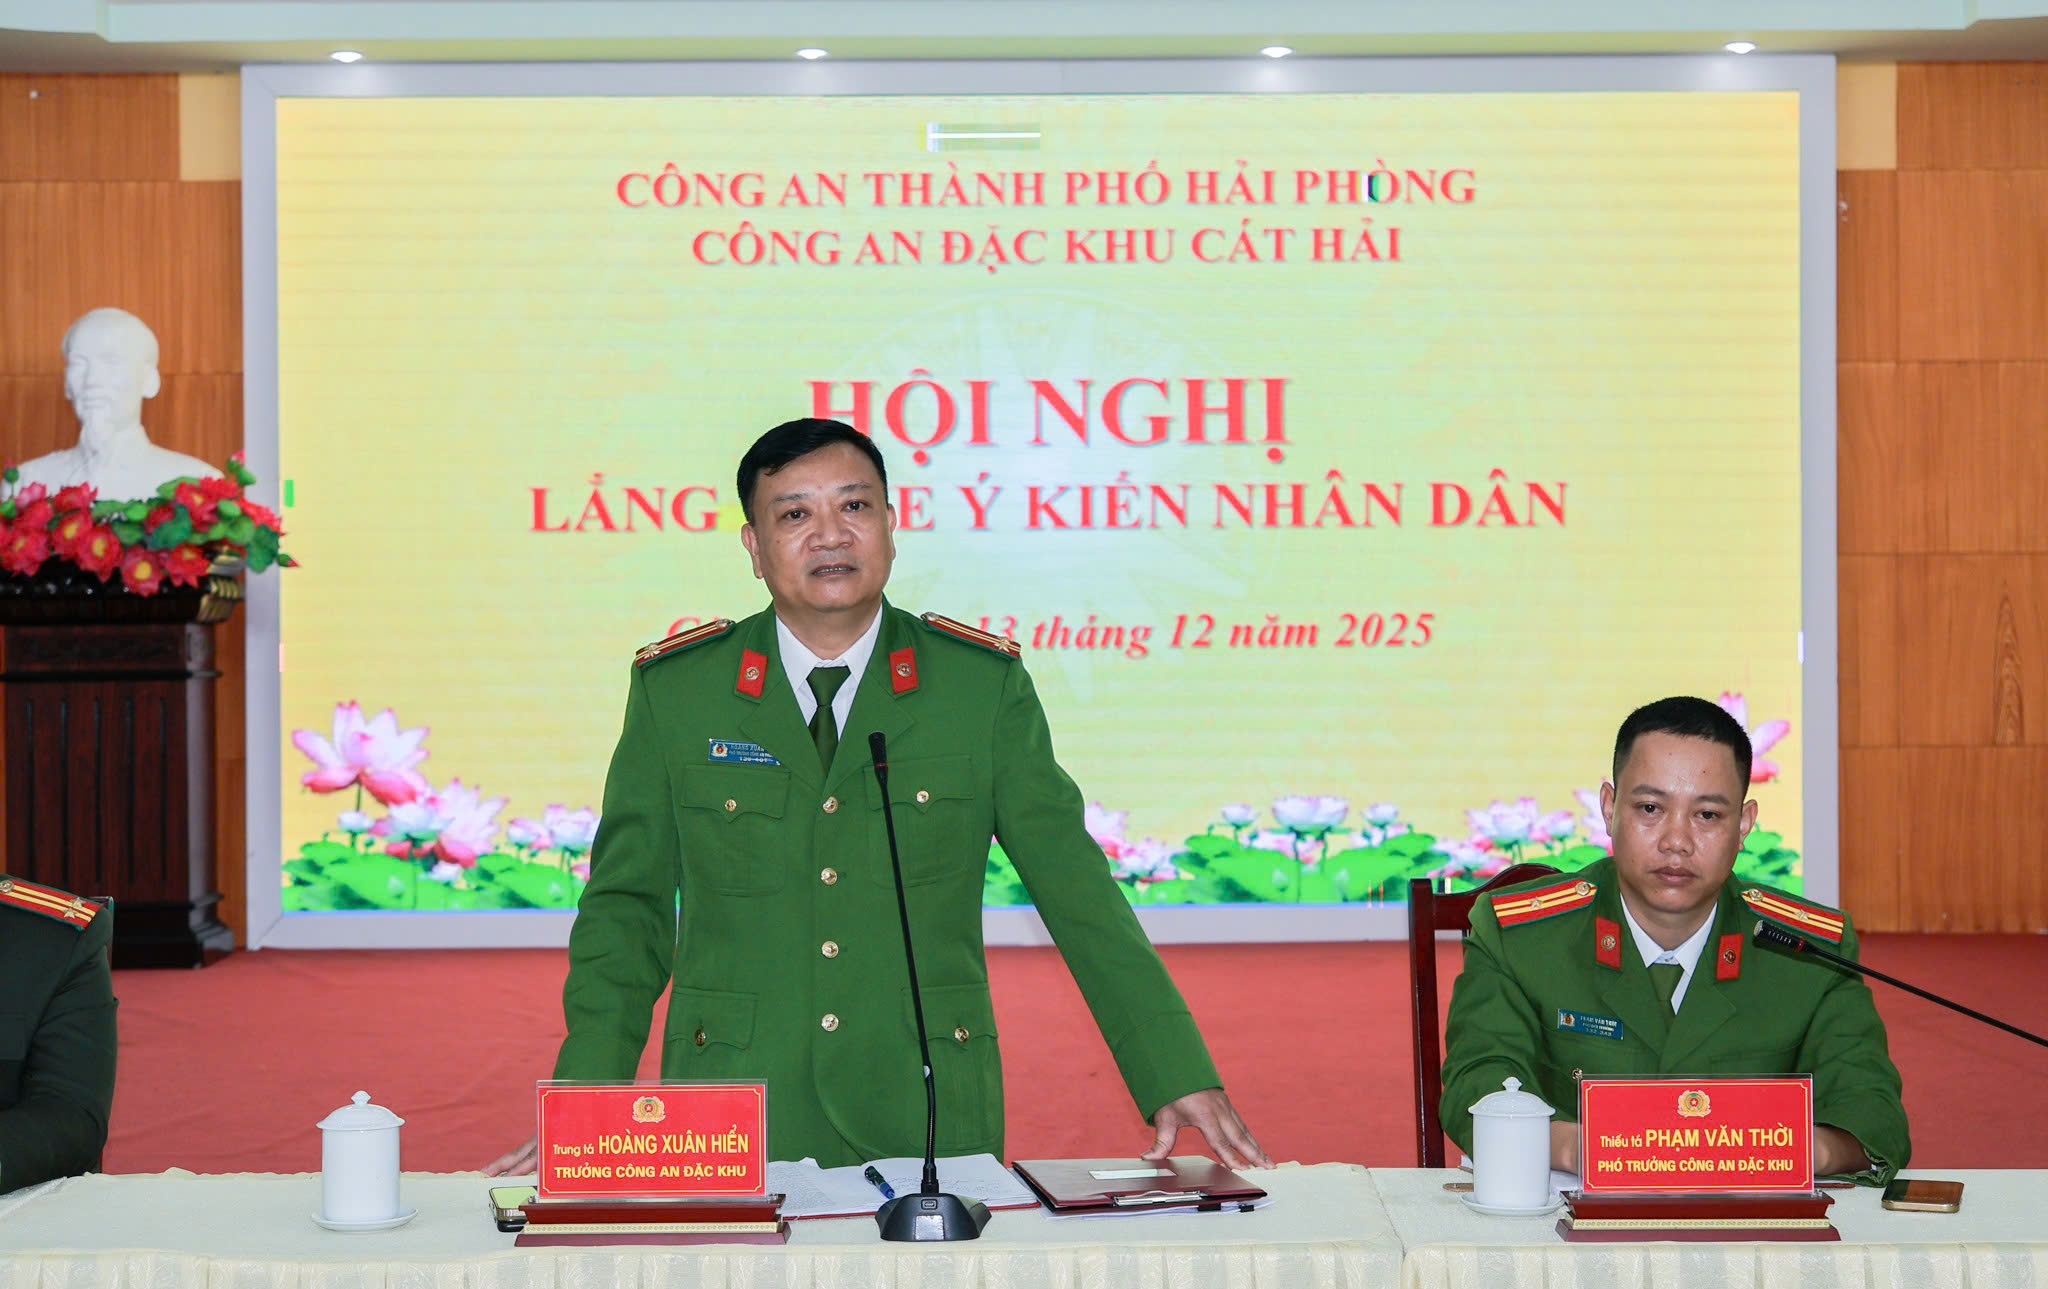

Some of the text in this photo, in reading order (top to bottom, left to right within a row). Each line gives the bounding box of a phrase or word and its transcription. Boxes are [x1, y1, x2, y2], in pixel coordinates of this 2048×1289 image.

[615, 158, 1476, 207] CÔNG AN THÀNH PHỐ HẢI PHÒNG
[690, 217, 1402, 273] CÔNG AN ĐẶC KHU CÁT HẢI
[806, 367, 1291, 466] HỘI NGHỊ
[958, 471, 1002, 531] Ý
[1025, 470, 1190, 530] KIẾN
[1211, 467, 1404, 529] NHÂN
[1428, 467, 1567, 528] DÂN
[1032, 614, 1152, 660] tháng
[1169, 613, 1216, 648] 12
[1228, 616, 1319, 648] năm
[1332, 612, 1434, 648] 2025
[553, 1123, 749, 1158] Trung tá HOÀNG XUÂN HIỂN
[1600, 1122, 1793, 1152] Thiếu tá PHẠM VĂN THỜI
[553, 1161, 747, 1181] TRƯỞNG CÔNG AN ĐẶC KHU
[1597, 1155, 1794, 1175] PHÓ TRƯỞNG CÔNG AN ĐẶC KHU
